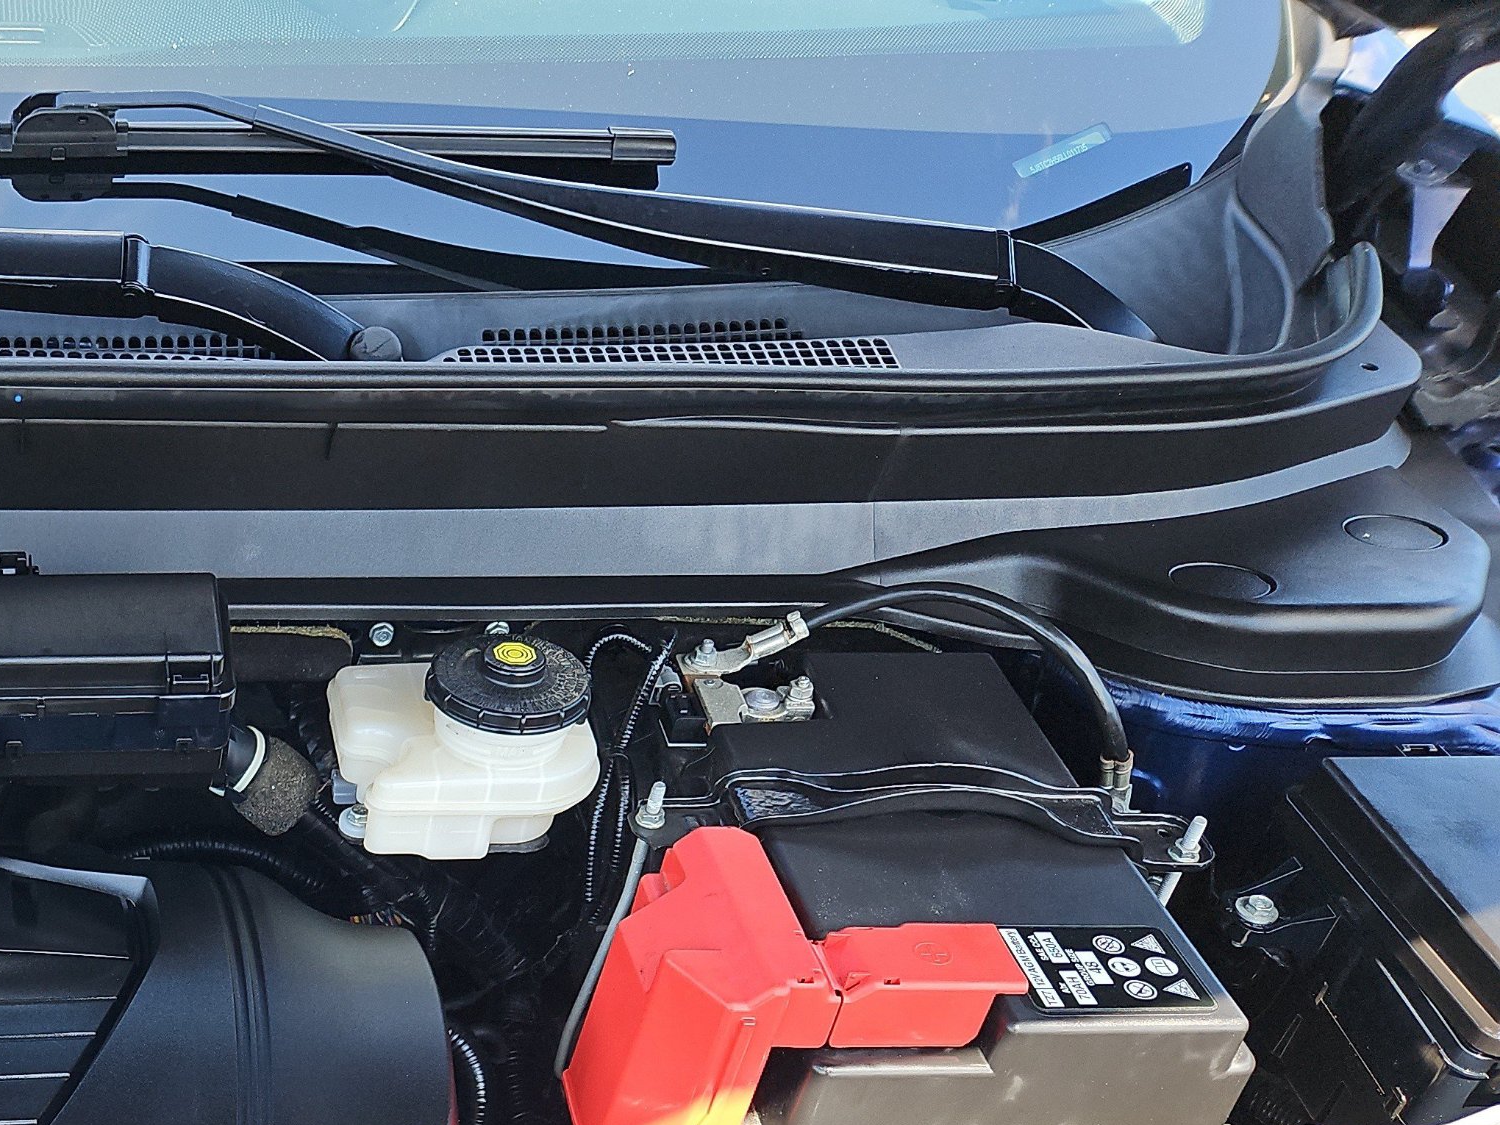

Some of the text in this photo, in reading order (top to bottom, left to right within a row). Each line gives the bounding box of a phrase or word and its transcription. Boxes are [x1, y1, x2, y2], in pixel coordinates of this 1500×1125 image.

[1005, 930, 1026, 955] Battery
[1042, 937, 1063, 958] 650A
[1075, 963, 1096, 986] GROUP
[1084, 961, 1102, 974] 48
[1066, 976, 1091, 1000] 70AH
